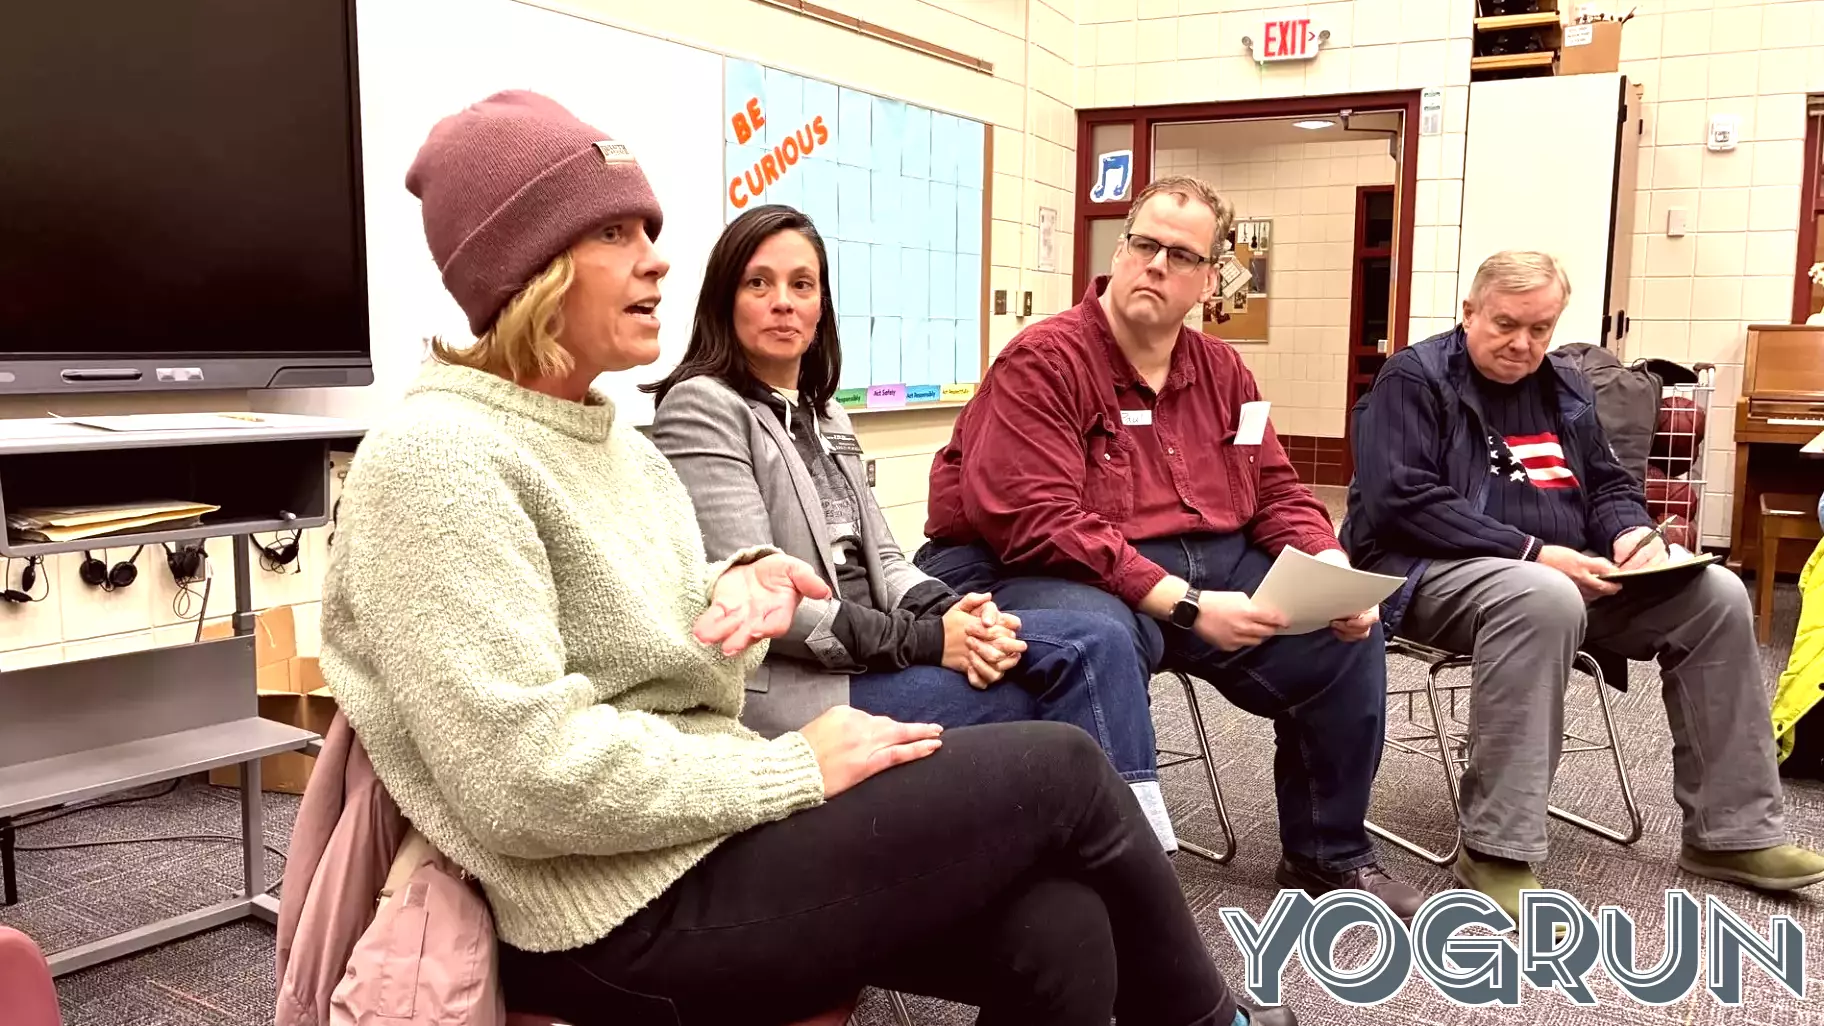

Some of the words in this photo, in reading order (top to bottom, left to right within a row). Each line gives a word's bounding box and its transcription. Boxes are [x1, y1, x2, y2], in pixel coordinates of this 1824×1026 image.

[1264, 19, 1310, 57] EXIT
[731, 97, 765, 145] BE
[729, 115, 828, 208] CURIOUS
